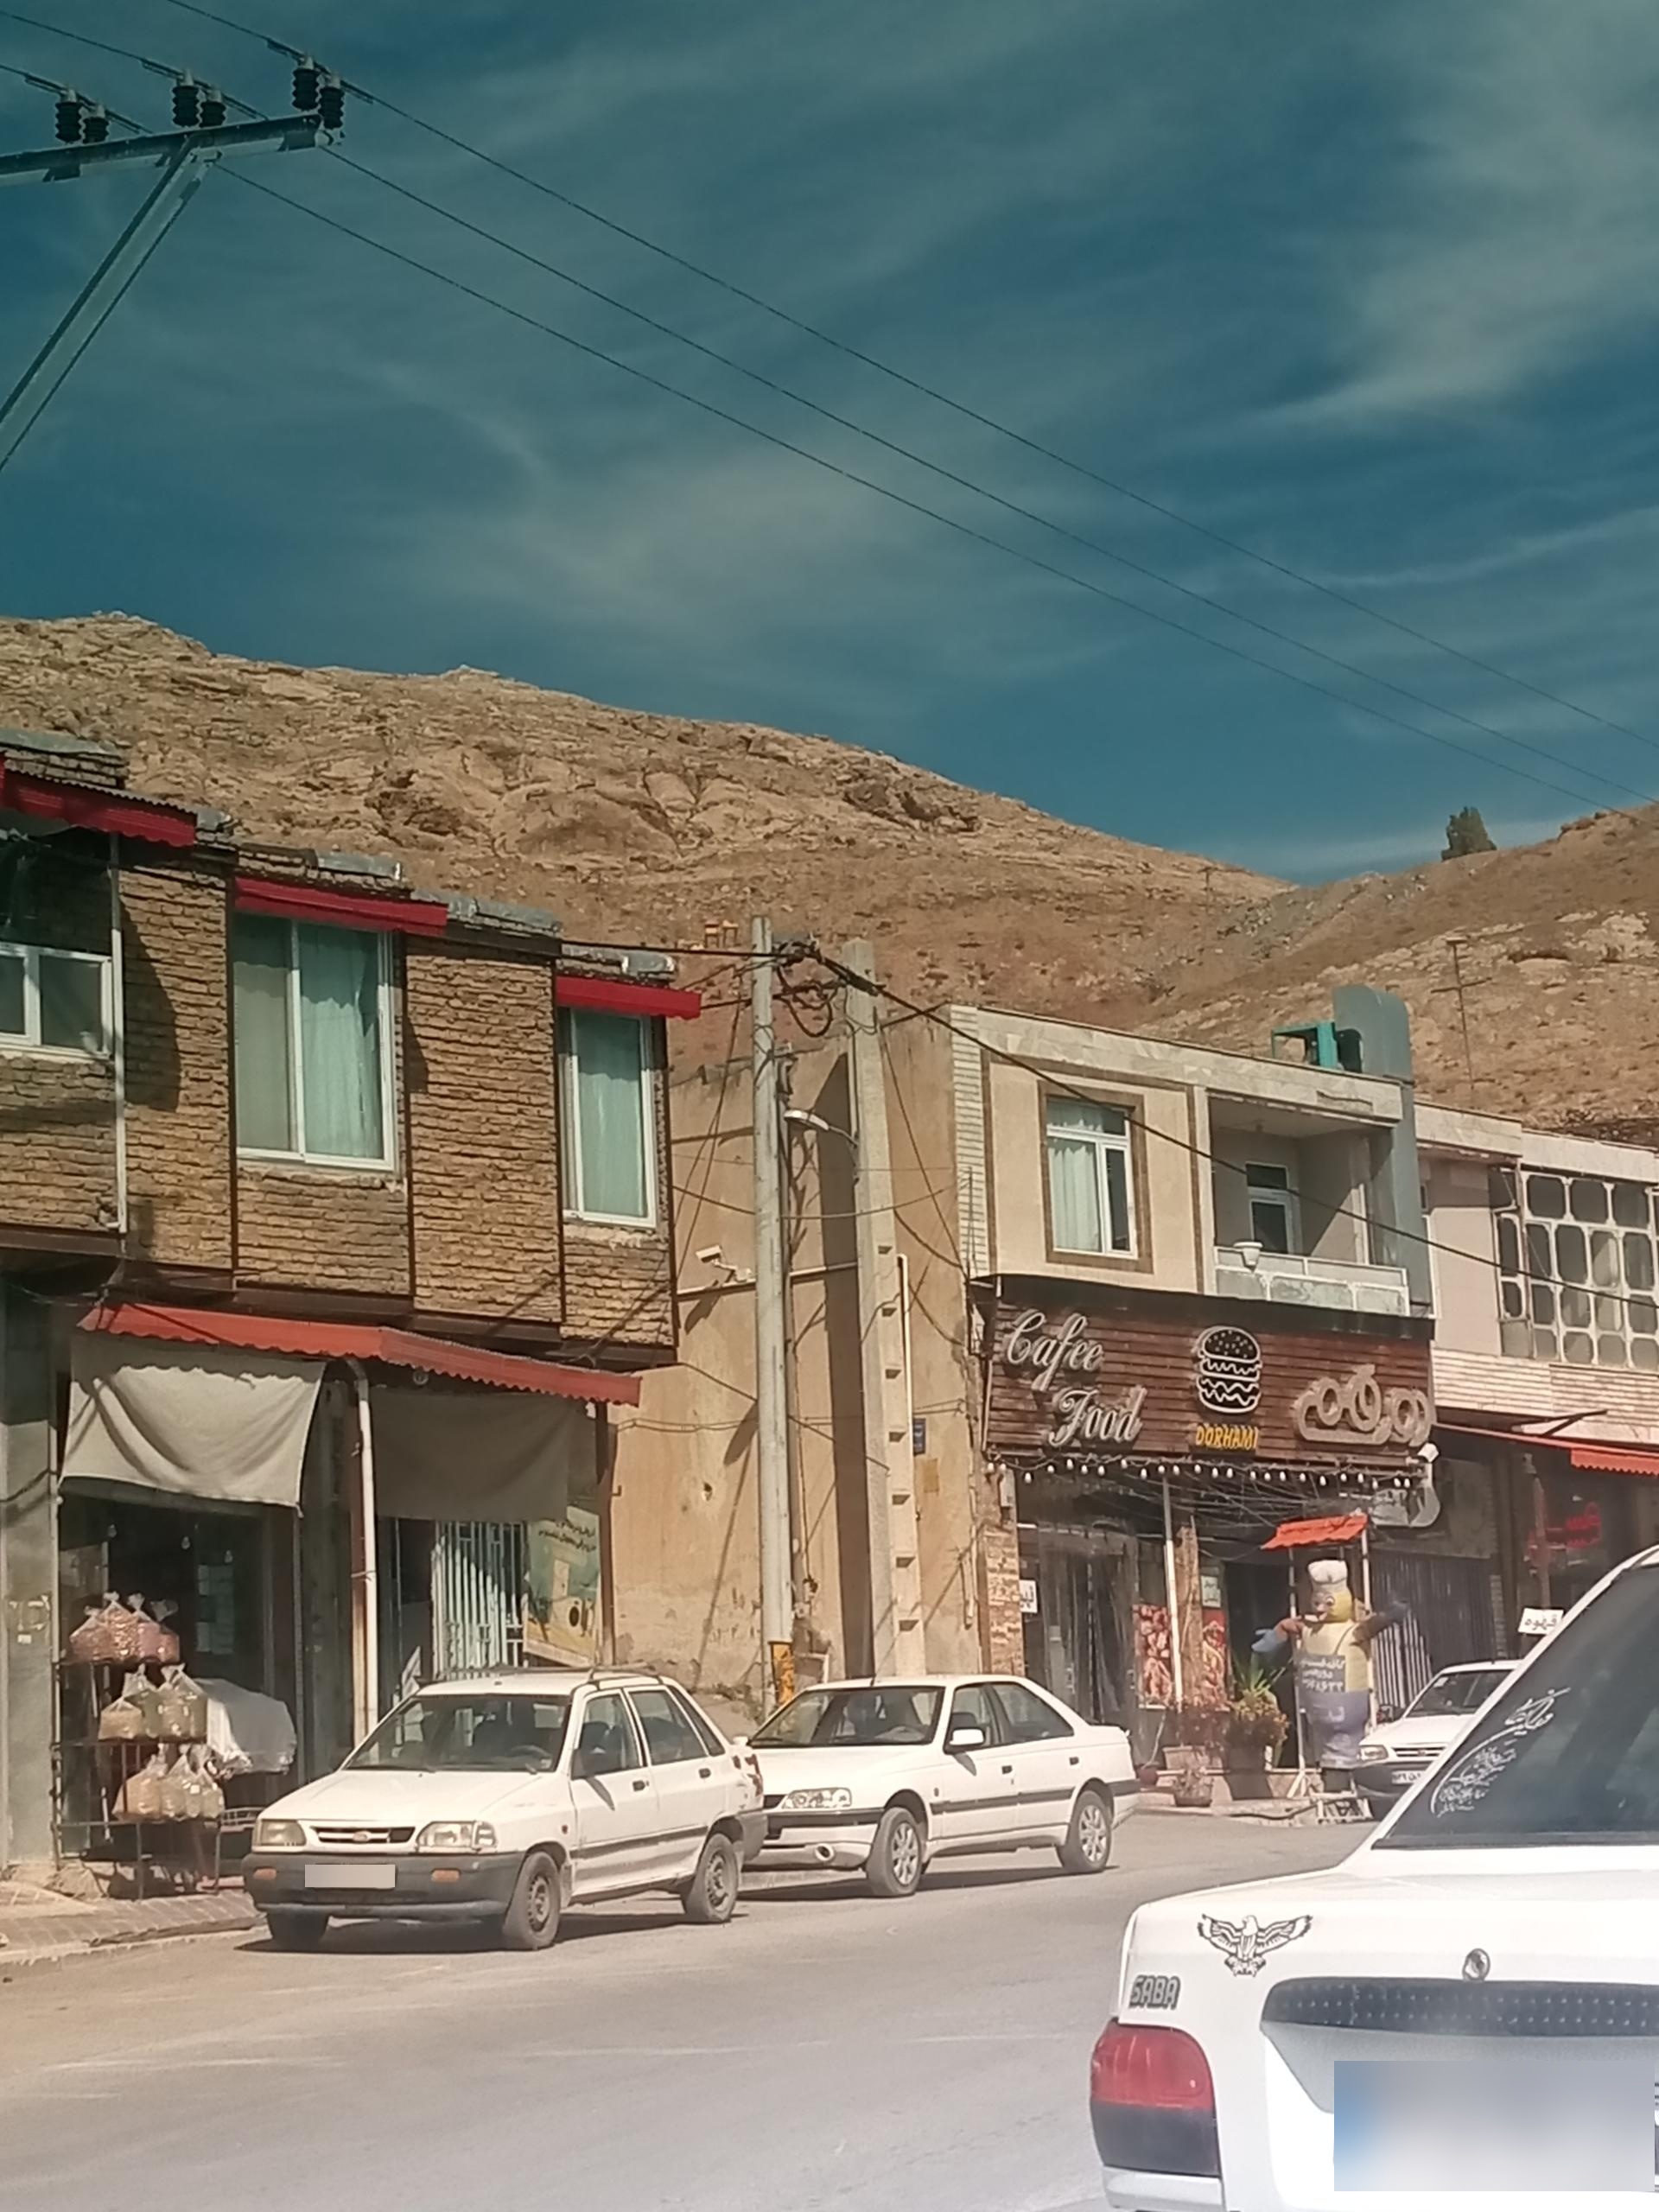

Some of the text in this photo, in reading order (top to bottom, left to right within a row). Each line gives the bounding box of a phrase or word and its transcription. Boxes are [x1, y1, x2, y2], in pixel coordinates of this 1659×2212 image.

[1005, 1310, 1103, 1392] Cafee
[1048, 1384, 1147, 1447] Food
[1193, 1423, 1260, 1451] DORHAMI
[1128, 1974, 1181, 2010] SABA
